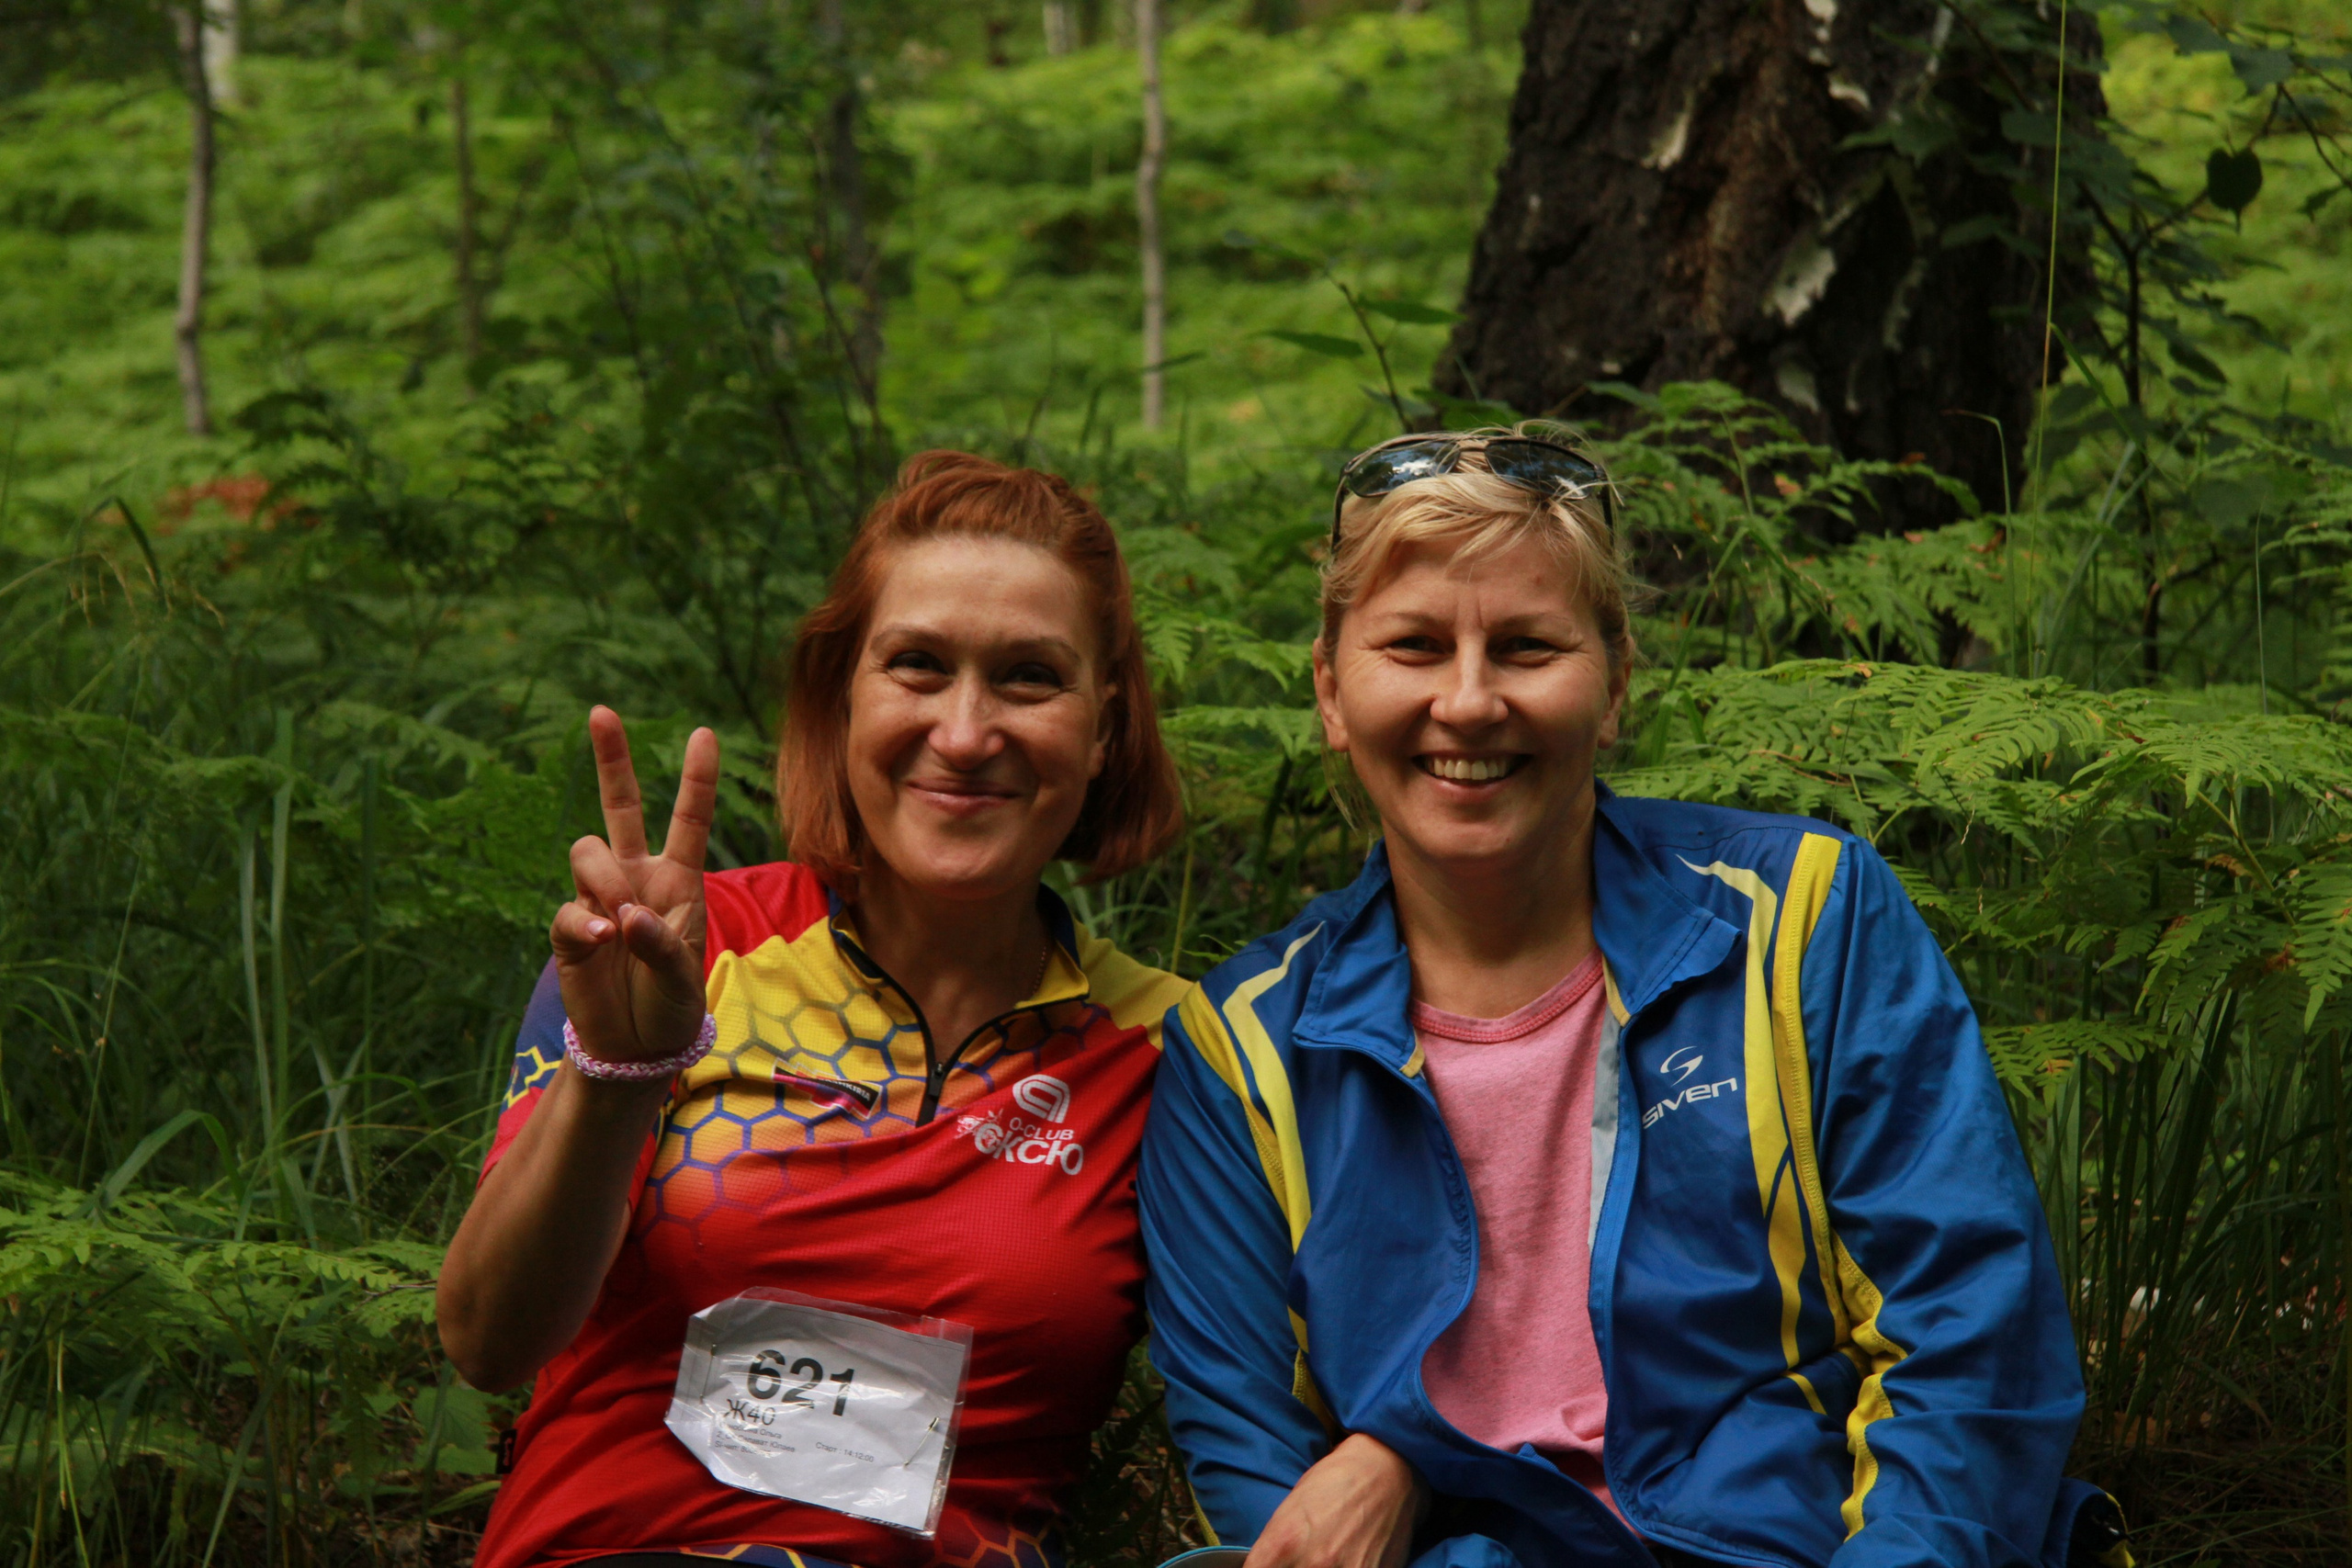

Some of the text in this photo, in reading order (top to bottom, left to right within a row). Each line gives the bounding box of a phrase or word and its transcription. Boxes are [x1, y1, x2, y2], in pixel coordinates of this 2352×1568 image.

[747, 1349, 854, 1416] 621
[723, 1398, 776, 1426] Ж40
[815, 1441, 838, 1452] Старт
